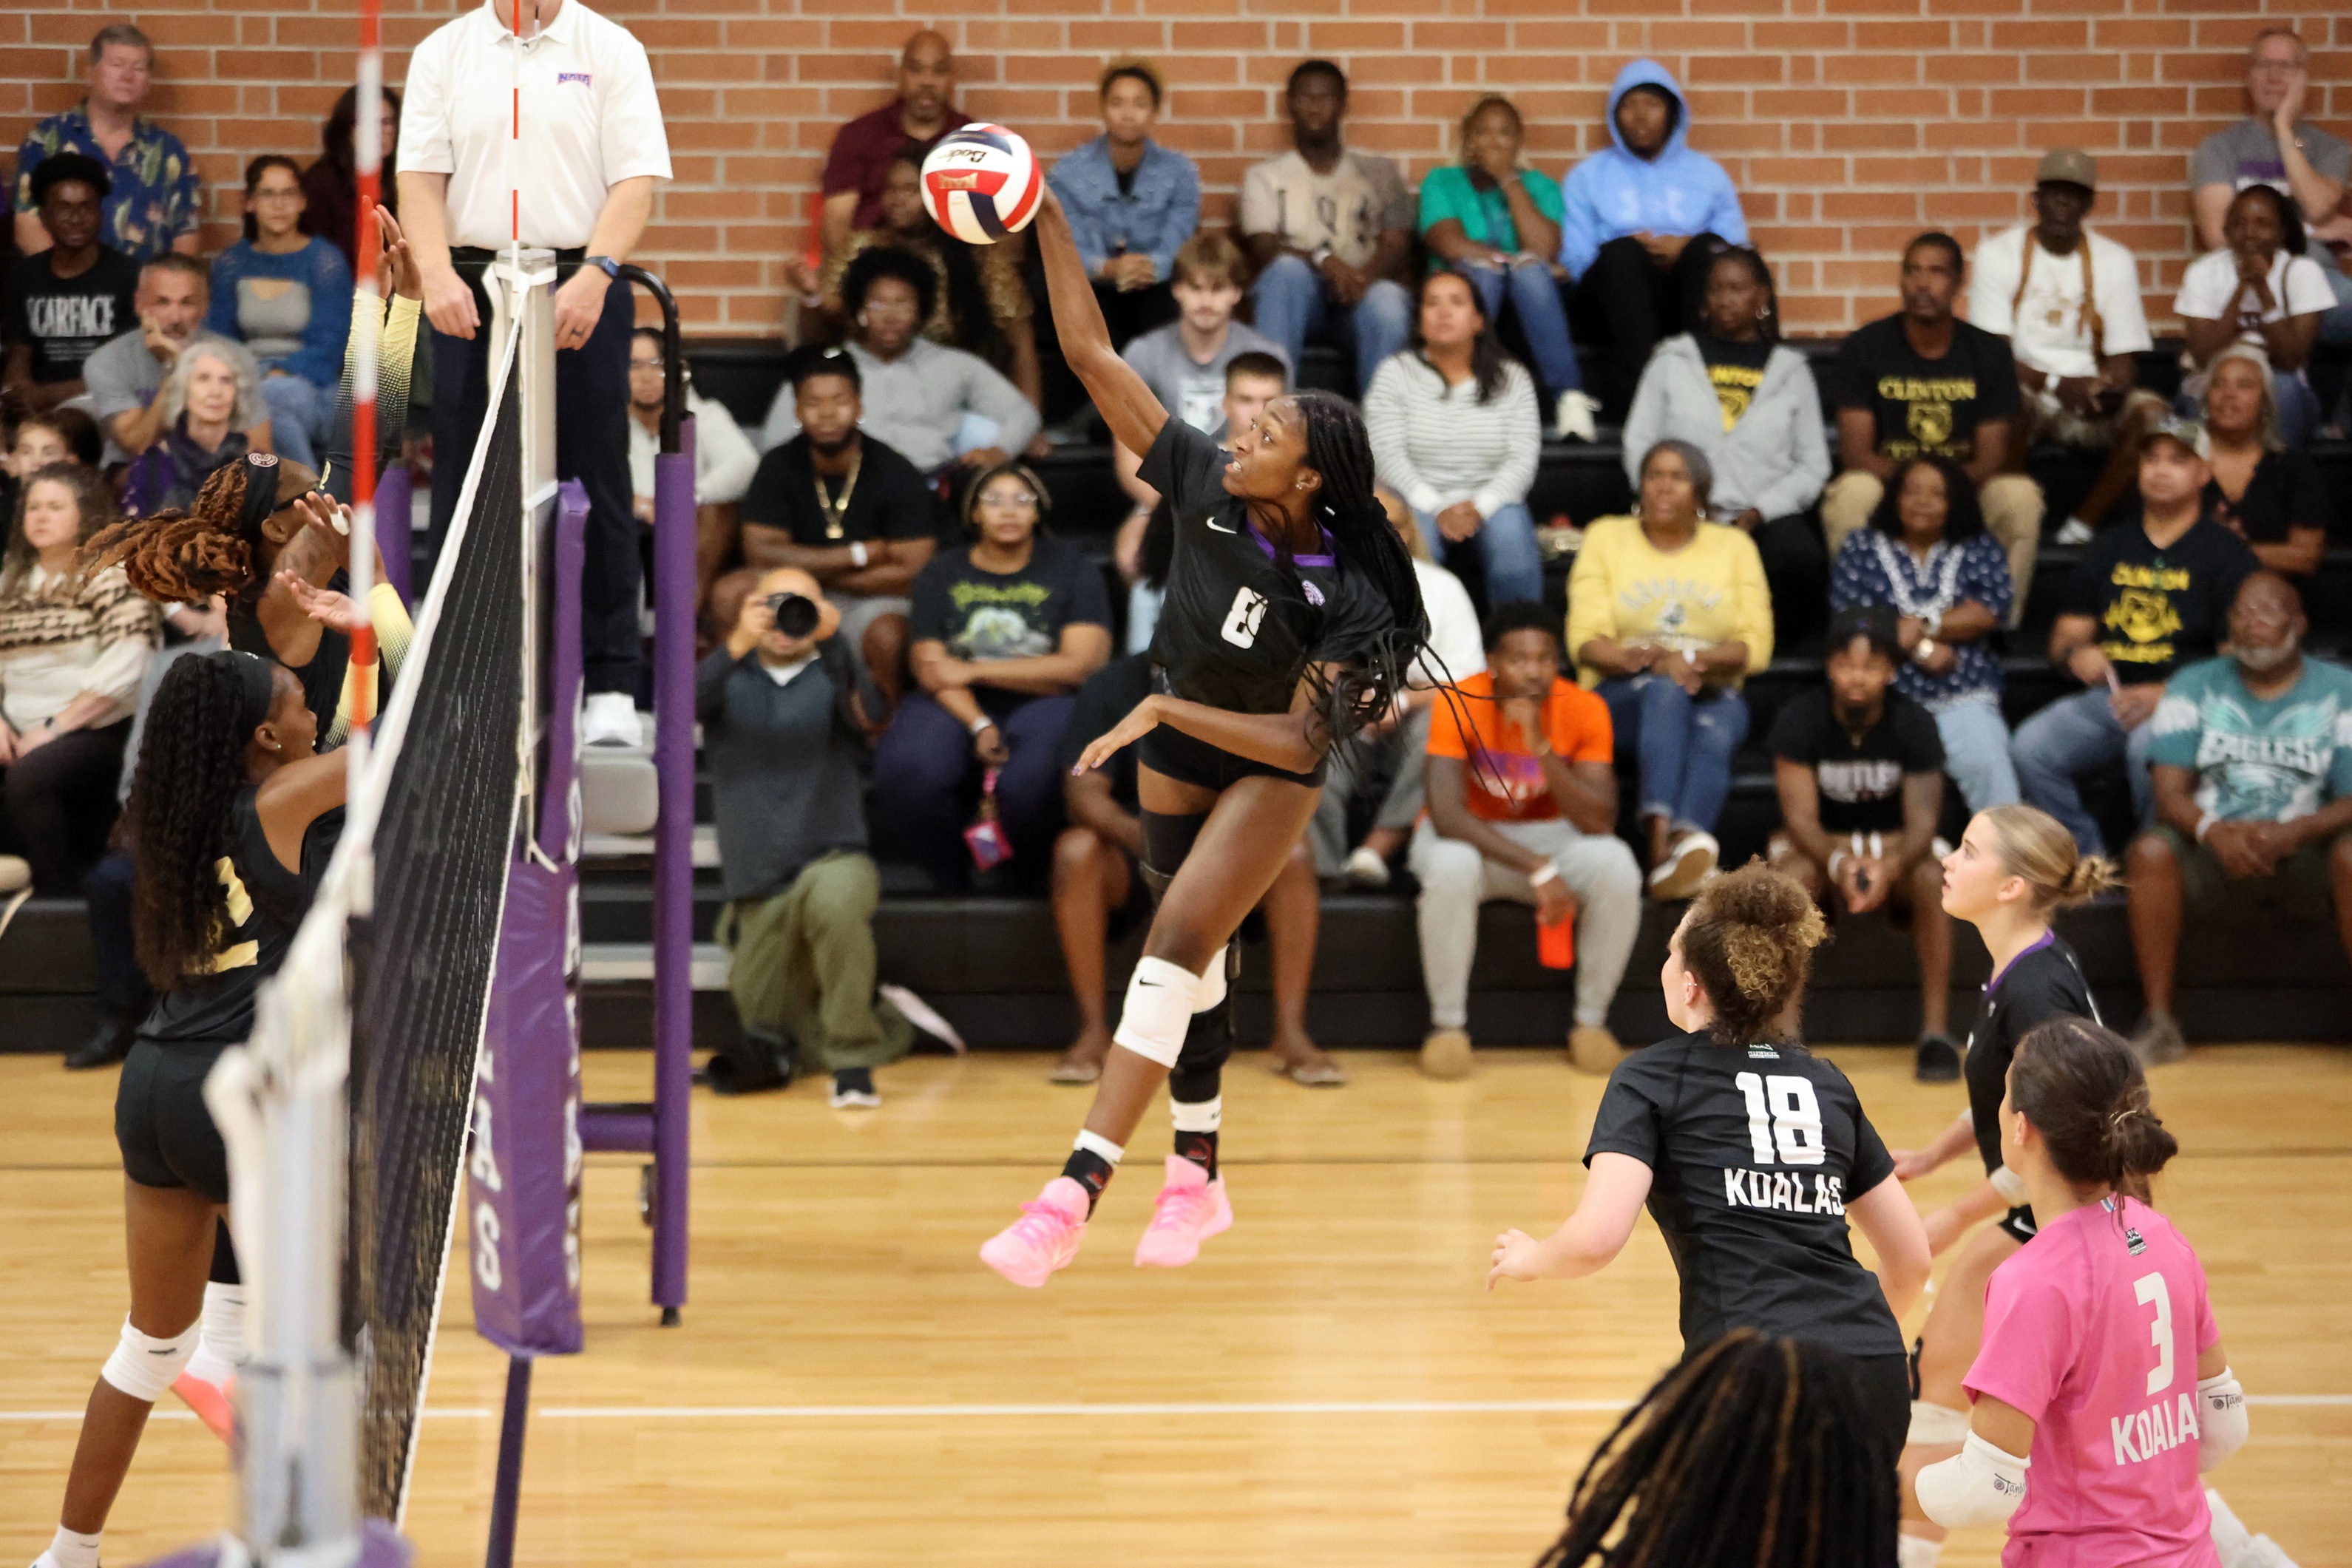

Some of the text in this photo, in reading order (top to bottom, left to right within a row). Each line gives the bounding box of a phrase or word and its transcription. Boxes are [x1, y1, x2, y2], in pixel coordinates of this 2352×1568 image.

[1735, 1072, 1826, 1165] 18
[1724, 1168, 1846, 1215] KOALAS
[2133, 1272, 2174, 1396] 3
[2111, 1391, 2199, 1465] KOALA
